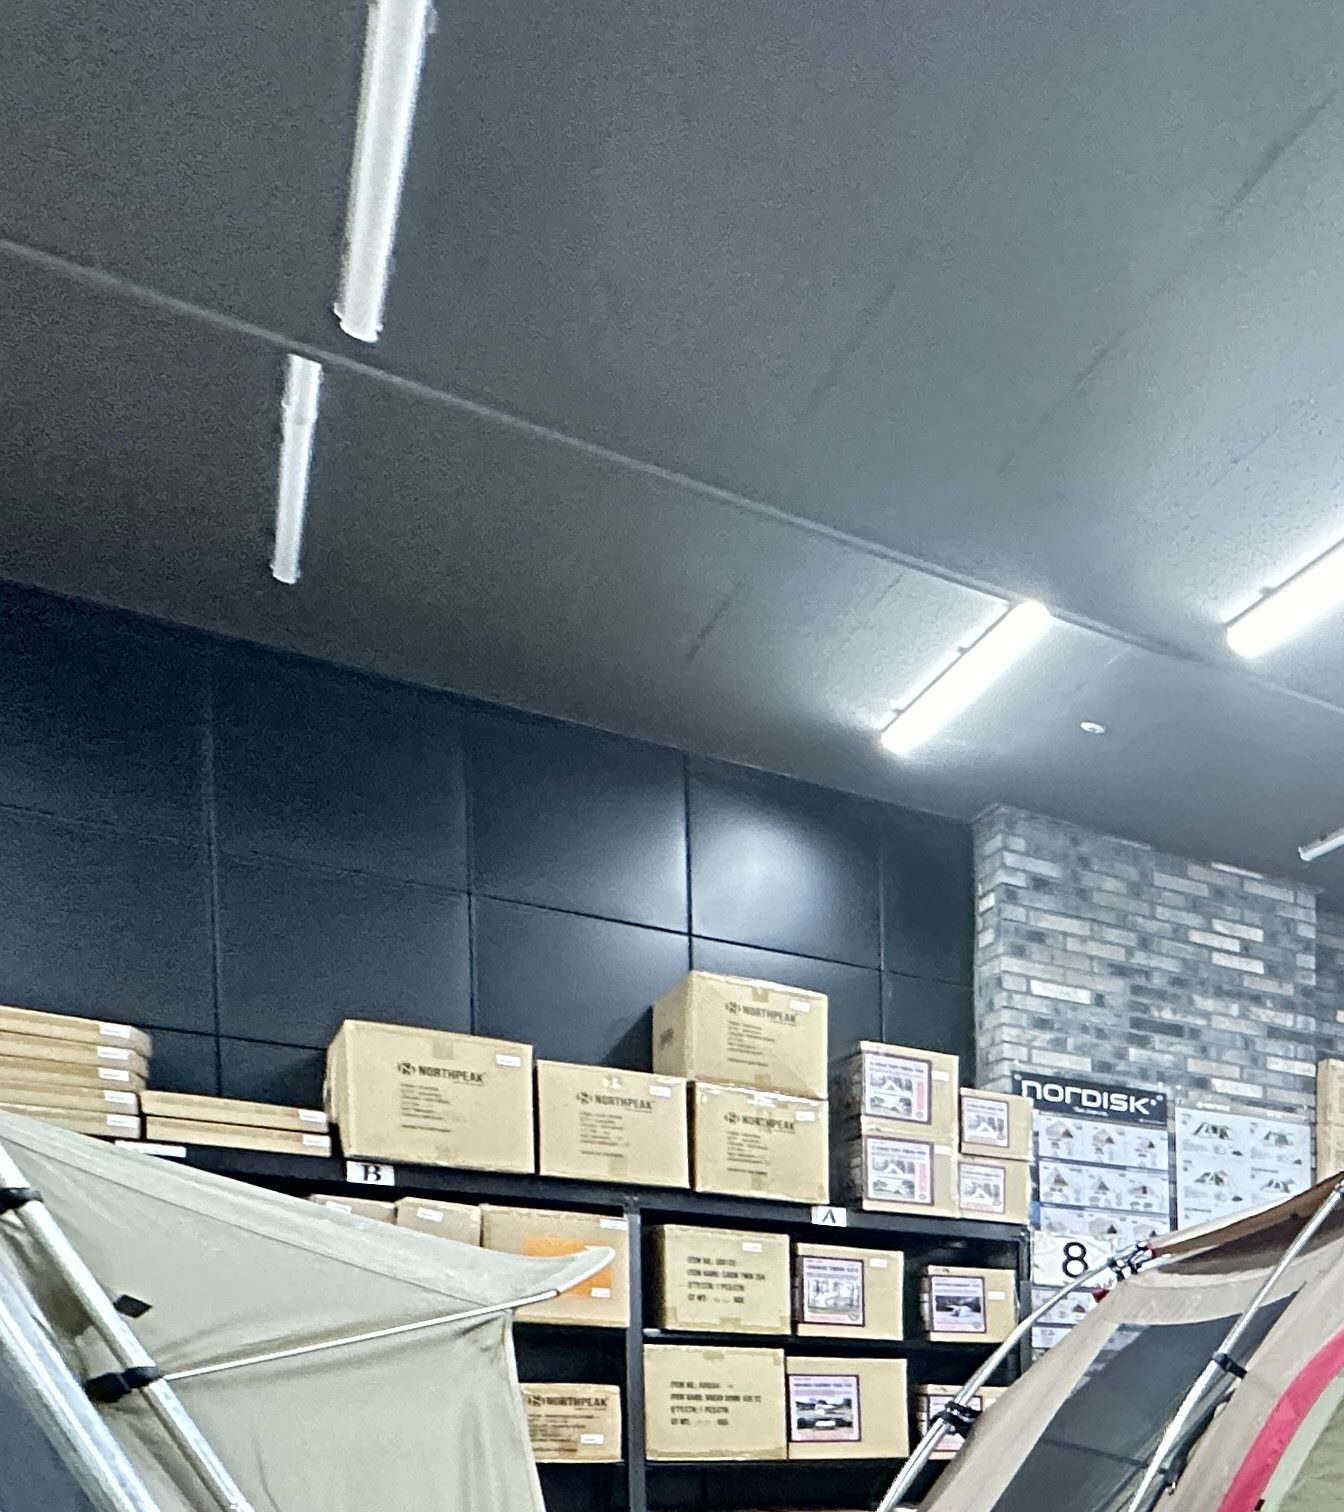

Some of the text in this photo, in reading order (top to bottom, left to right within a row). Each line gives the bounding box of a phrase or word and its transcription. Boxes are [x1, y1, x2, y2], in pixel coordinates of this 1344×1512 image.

[418, 1065, 484, 1082] NORTHPEAK
[362, 1164, 382, 1181] B
[1062, 1241, 1089, 1277] 8
